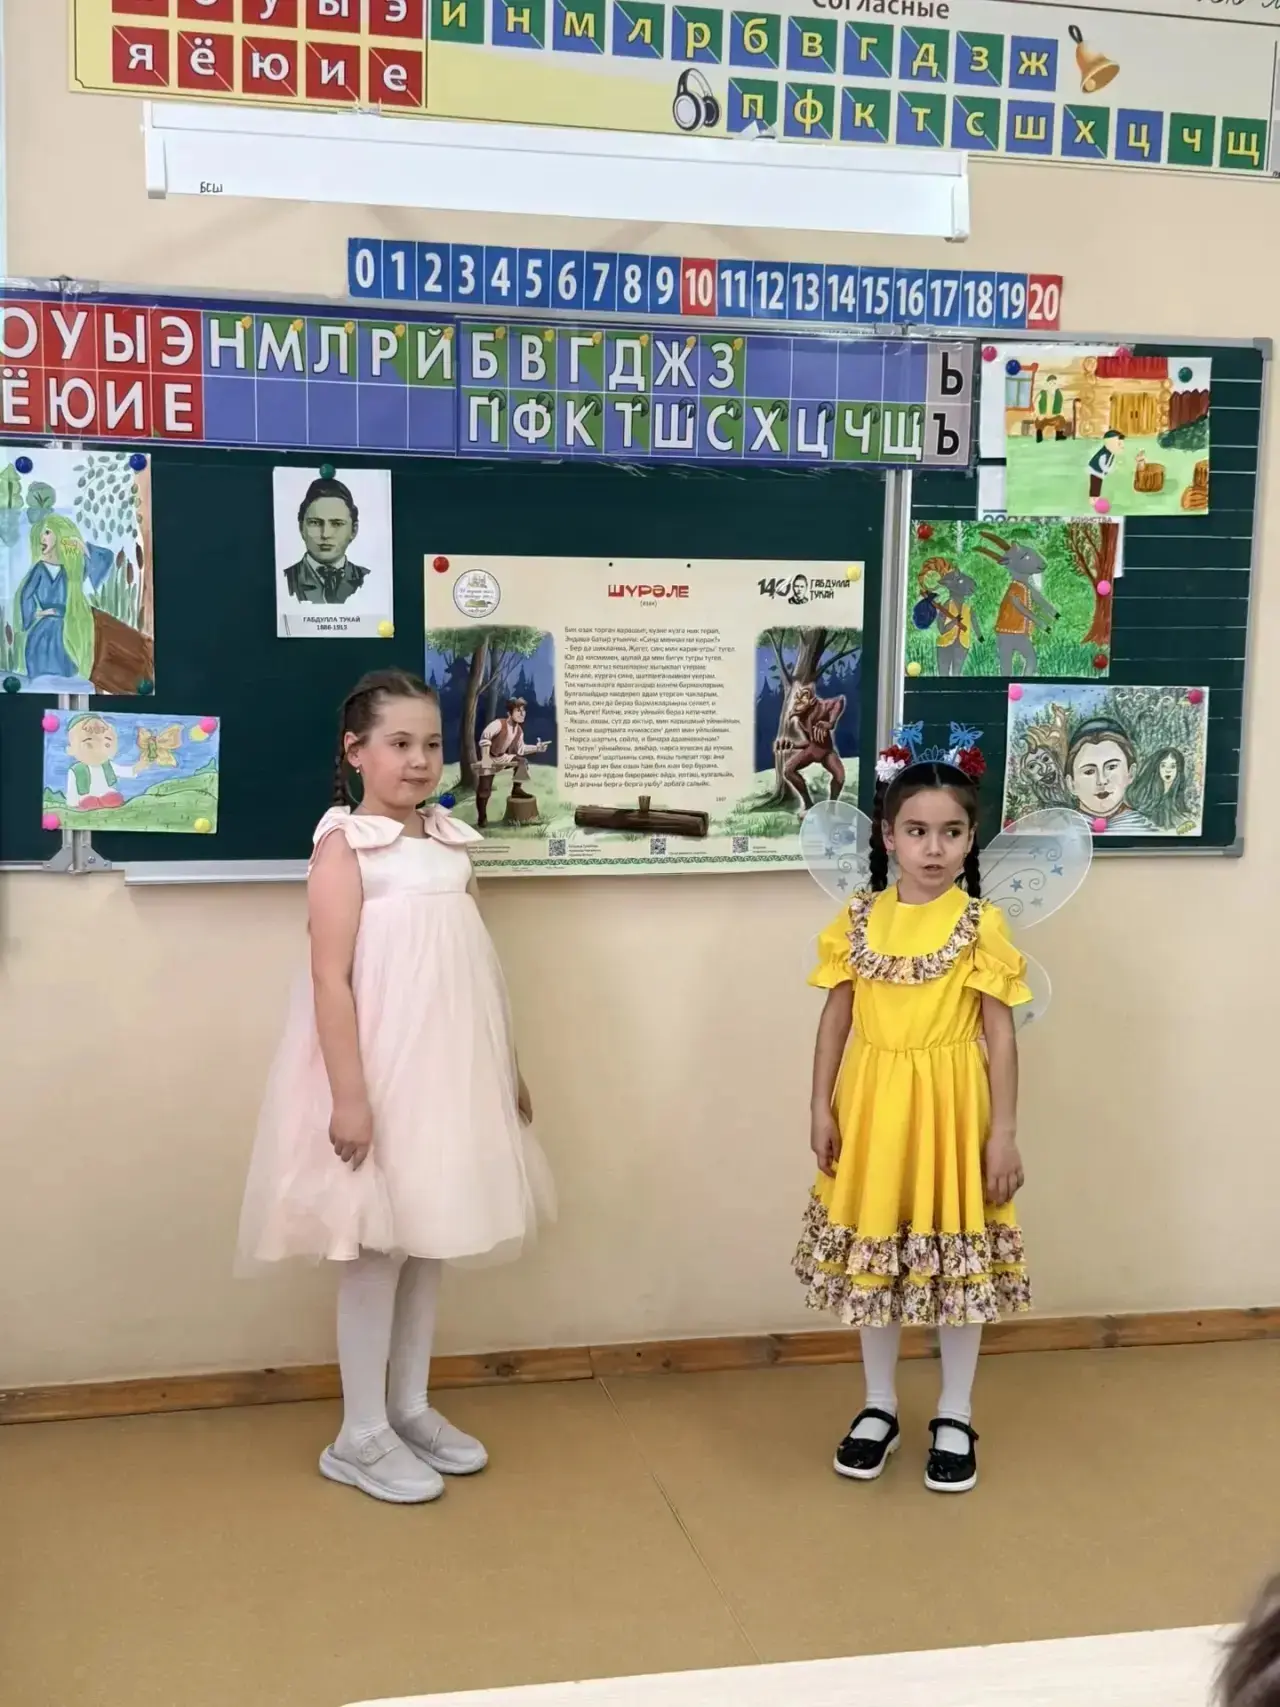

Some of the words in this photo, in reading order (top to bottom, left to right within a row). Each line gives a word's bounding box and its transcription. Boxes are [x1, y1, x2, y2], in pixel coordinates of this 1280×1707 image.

[386, 0, 406, 21] э
[443, 1, 465, 27] и
[508, 7, 529, 33] н
[565, 11, 594, 37] м
[627, 18, 652, 44] л
[687, 21, 711, 58] р
[744, 18, 768, 53] б
[803, 32, 822, 56] в
[859, 35, 877, 60] г
[913, 44, 938, 77] д
[970, 44, 988, 70] з
[1019, 52, 1048, 76] ж
[129, 44, 152, 70] я
[191, 38, 214, 75] ё
[252, 53, 288, 80] ю
[321, 59, 344, 85] и
[384, 65, 407, 91] е
[743, 94, 763, 119] п
[795, 89, 822, 131] ф
[855, 103, 874, 127] к
[912, 108, 934, 135] т
[963, 107, 984, 136] с
[1015, 116, 1045, 139] ш
[1075, 120, 1095, 143] х
[1129, 124, 1149, 155] ц
[1183, 128, 1201, 151] ч
[1228, 132, 1259, 159] щ
[356, 249, 374, 288] 0
[391, 251, 404, 290] 1
[425, 253, 442, 292] 2
[459, 255, 475, 294] 3
[491, 258, 510, 296] 4
[526, 259, 542, 298] 5
[559, 261, 576, 300] 6
[593, 263, 609, 301] 7
[624, 265, 641, 303] 8
[656, 267, 673, 304] 9
[686, 269, 712, 306] 10
[721, 270, 745, 307] 11
[757, 272, 783, 309] 12
[792, 273, 819, 311] 13
[828, 275, 855, 312] 14
[863, 277, 889, 314] 15
[897, 278, 924, 316] 16
[931, 280, 958, 316] 17
[964, 281, 992, 318] 18
[999, 282, 1025, 319] 19
[1029, 284, 1059, 321] 20
[0, 307, 37, 357] О
[51, 311, 87, 359] У
[105, 313, 145, 363] Ы
[161, 316, 193, 365] Э
[211, 320, 244, 368] Н
[258, 321, 303, 371] М
[314, 325, 350, 373] Л
[372, 328, 398, 375] Р
[418, 327, 453, 379] Й
[473, 333, 497, 378] Б
[522, 335, 545, 380] В
[571, 337, 593, 382] Г
[609, 339, 644, 391] Д
[655, 337, 695, 386] Ж
[709, 343, 735, 388] З
[941, 352, 963, 395] Ь
[1, 369, 30, 424] Ё
[49, 378, 95, 428] Ю
[107, 381, 143, 429] И
[165, 384, 192, 431] Е
[470, 397, 499, 442] П
[514, 399, 551, 443] Ф
[567, 401, 594, 445] К
[616, 403, 641, 446] Т
[655, 404, 694, 448] Ш
[707, 406, 733, 450] С
[751, 407, 780, 450] Х
[798, 409, 828, 457] Ц
[845, 410, 870, 453] Ч
[884, 412, 921, 460] Щ
[933, 413, 959, 455] Ъ
[339, 615, 361, 623] ТУКАЙ
[608, 584, 689, 598] ШҮРӘЛЕ
